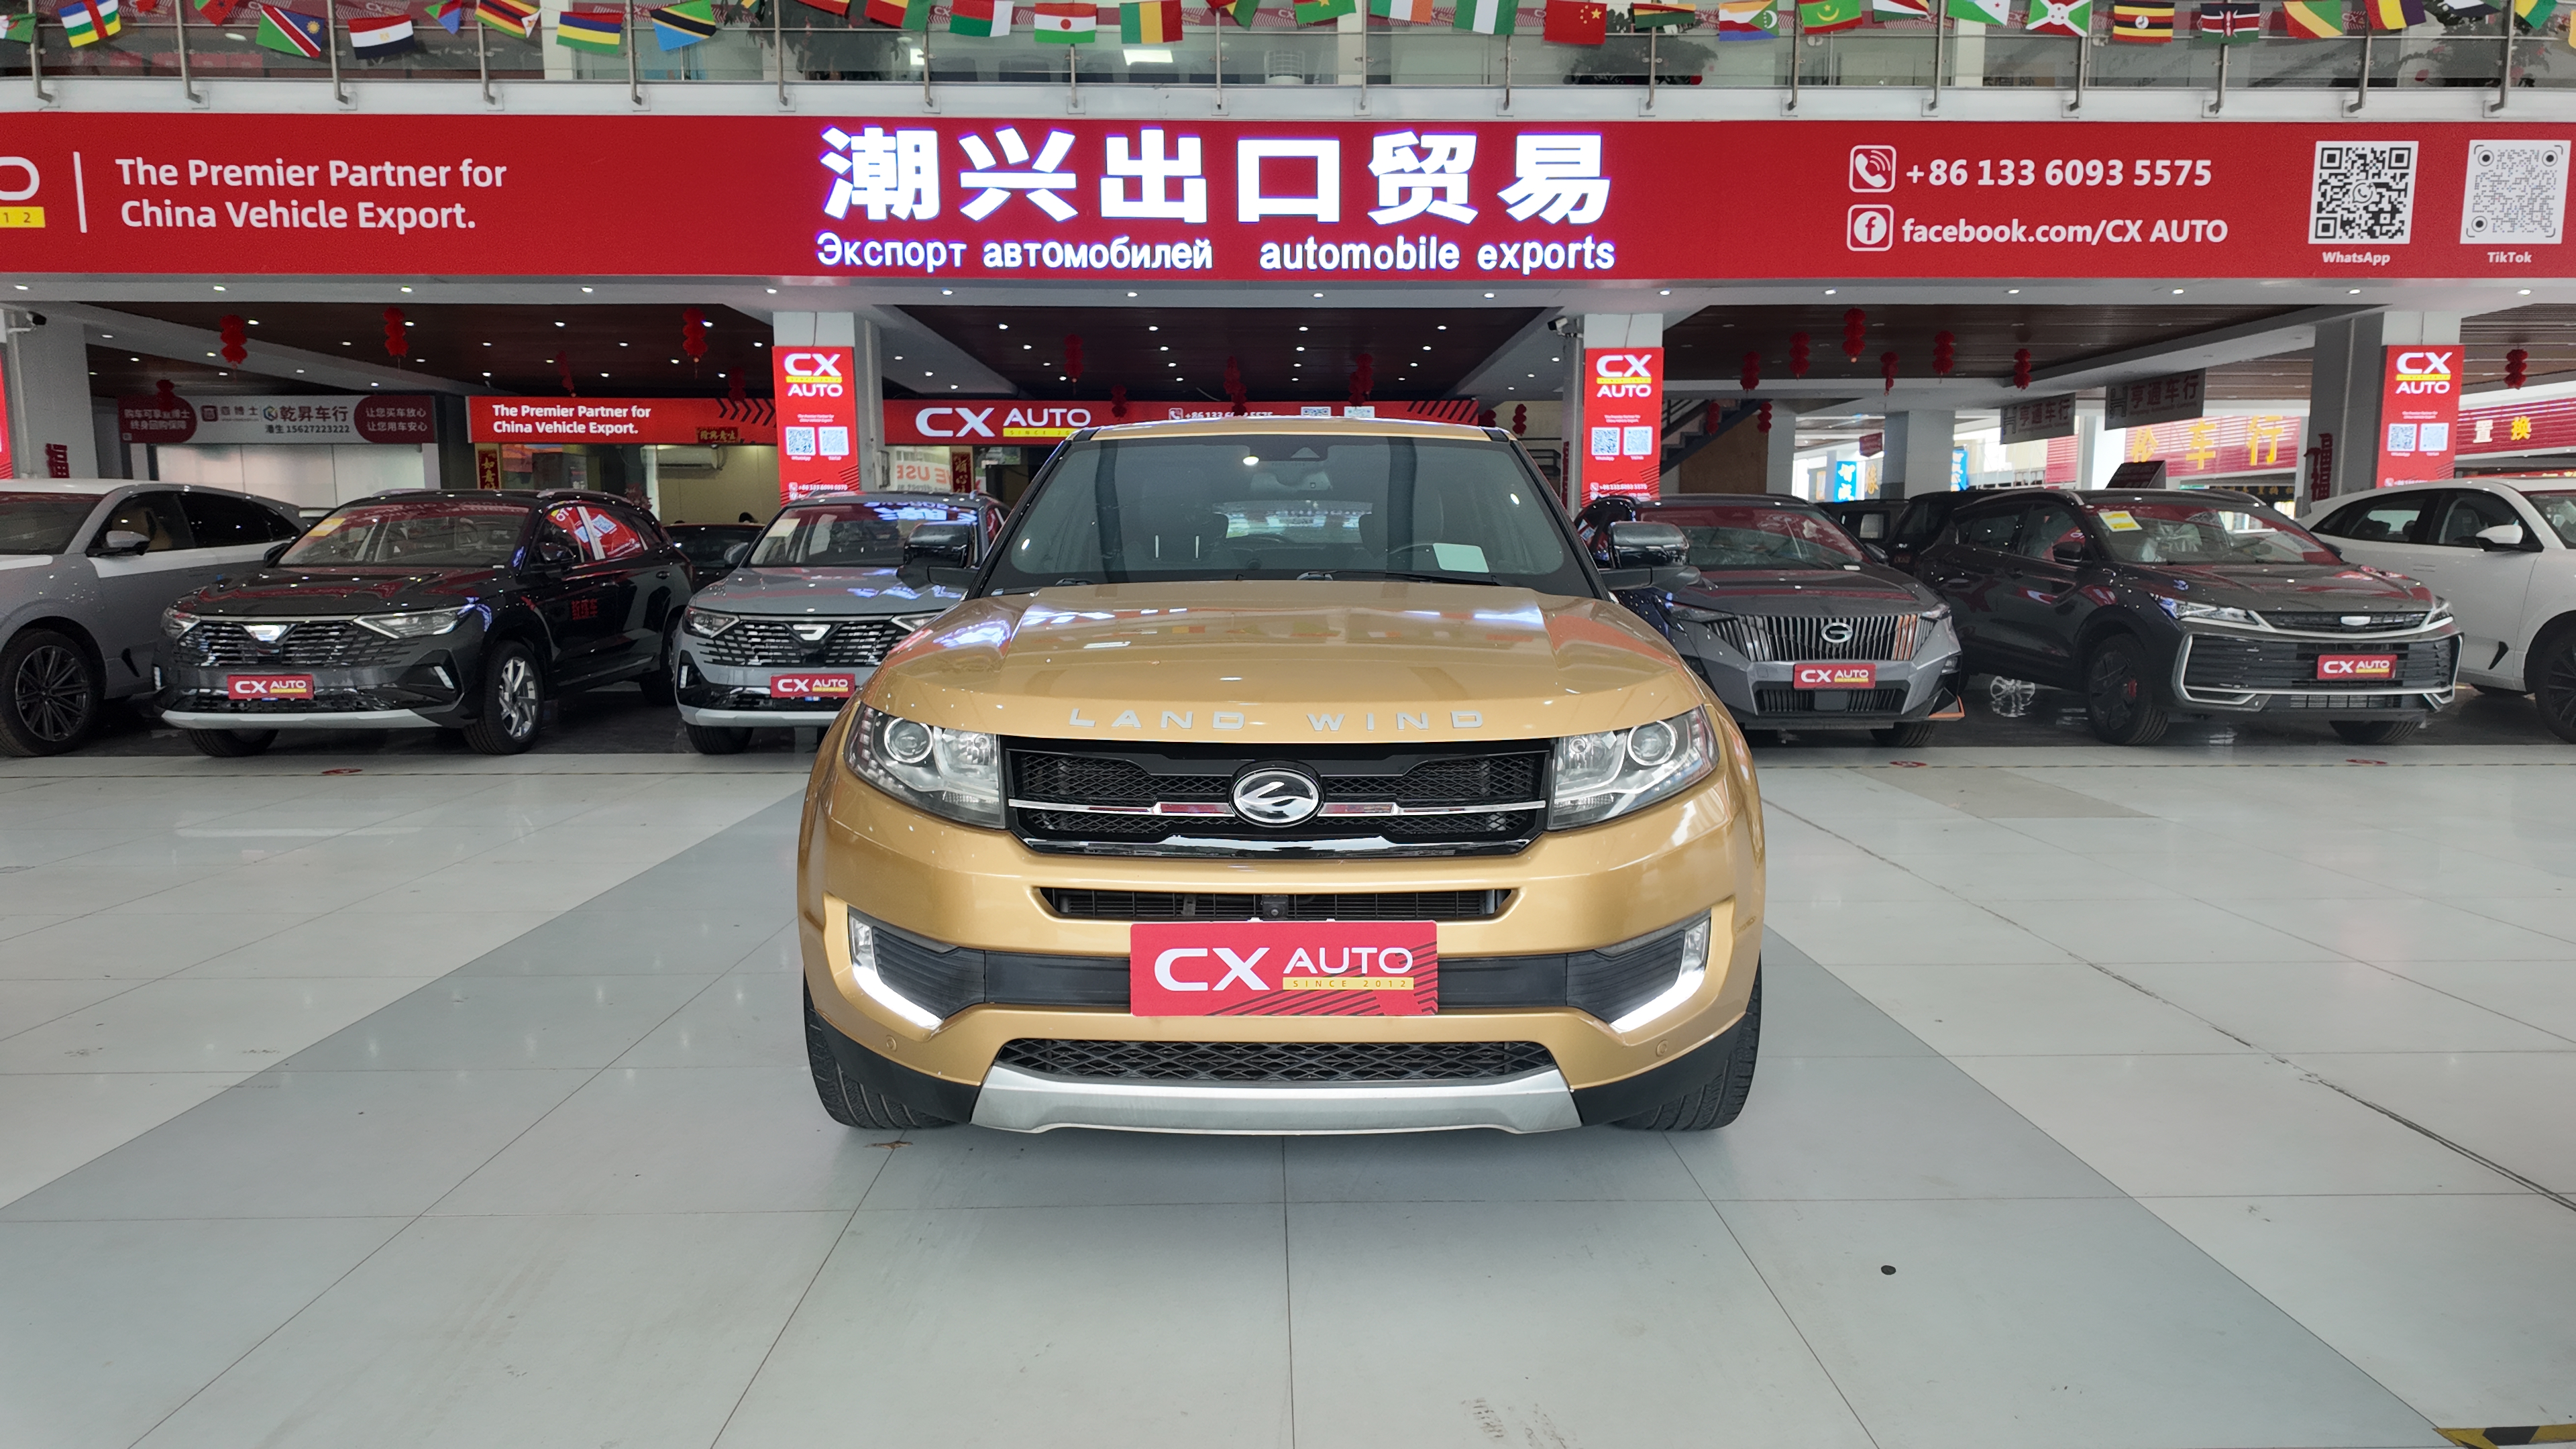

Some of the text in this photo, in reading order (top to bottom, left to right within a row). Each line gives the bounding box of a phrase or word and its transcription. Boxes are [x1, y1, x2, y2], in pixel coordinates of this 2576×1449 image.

[934, 7, 951, 16] CX
[1278, 9, 1295, 19] CX
[115, 157, 508, 188] The Premier Partner for
[820, 126, 1611, 226] 潮兴出口贸易
[1906, 159, 2212, 186] +86 133 6093 5575
[121, 199, 476, 235] China Vehicle Export.
[1902, 217, 2229, 246] facebook.com/CX AUTO
[817, 232, 1213, 273] Экспорт автомобилей
[1259, 235, 1616, 276] automobile exports
[2322, 251, 2391, 266] WhatsApp
[2487, 251, 2533, 264] TikTok
[784, 352, 842, 376] CX
[1596, 354, 1652, 377] CX
[2396, 352, 2453, 374] CX
[787, 383, 843, 398] AUTO
[1596, 384, 1652, 398] AUTO
[2395, 380, 2451, 394] AUTO
[492, 404, 651, 418] The Premier Partner for
[493, 421, 639, 436] China Vehicle Export.
[915, 407, 1091, 437] CX AUTO
[2323, 659, 2390, 674] CX AUTO
[1801, 669, 1832, 683] CX
[1834, 669, 1869, 678] AUTO
[234, 680, 268, 694] CX
[270, 680, 307, 689] AUTO
[777, 678, 848, 692] CX AUTO
[1069, 708, 1484, 731] LAND WIND
[1154, 947, 1413, 992] CX AUTO
[1293, 980, 1406, 988] SINCE 2012
